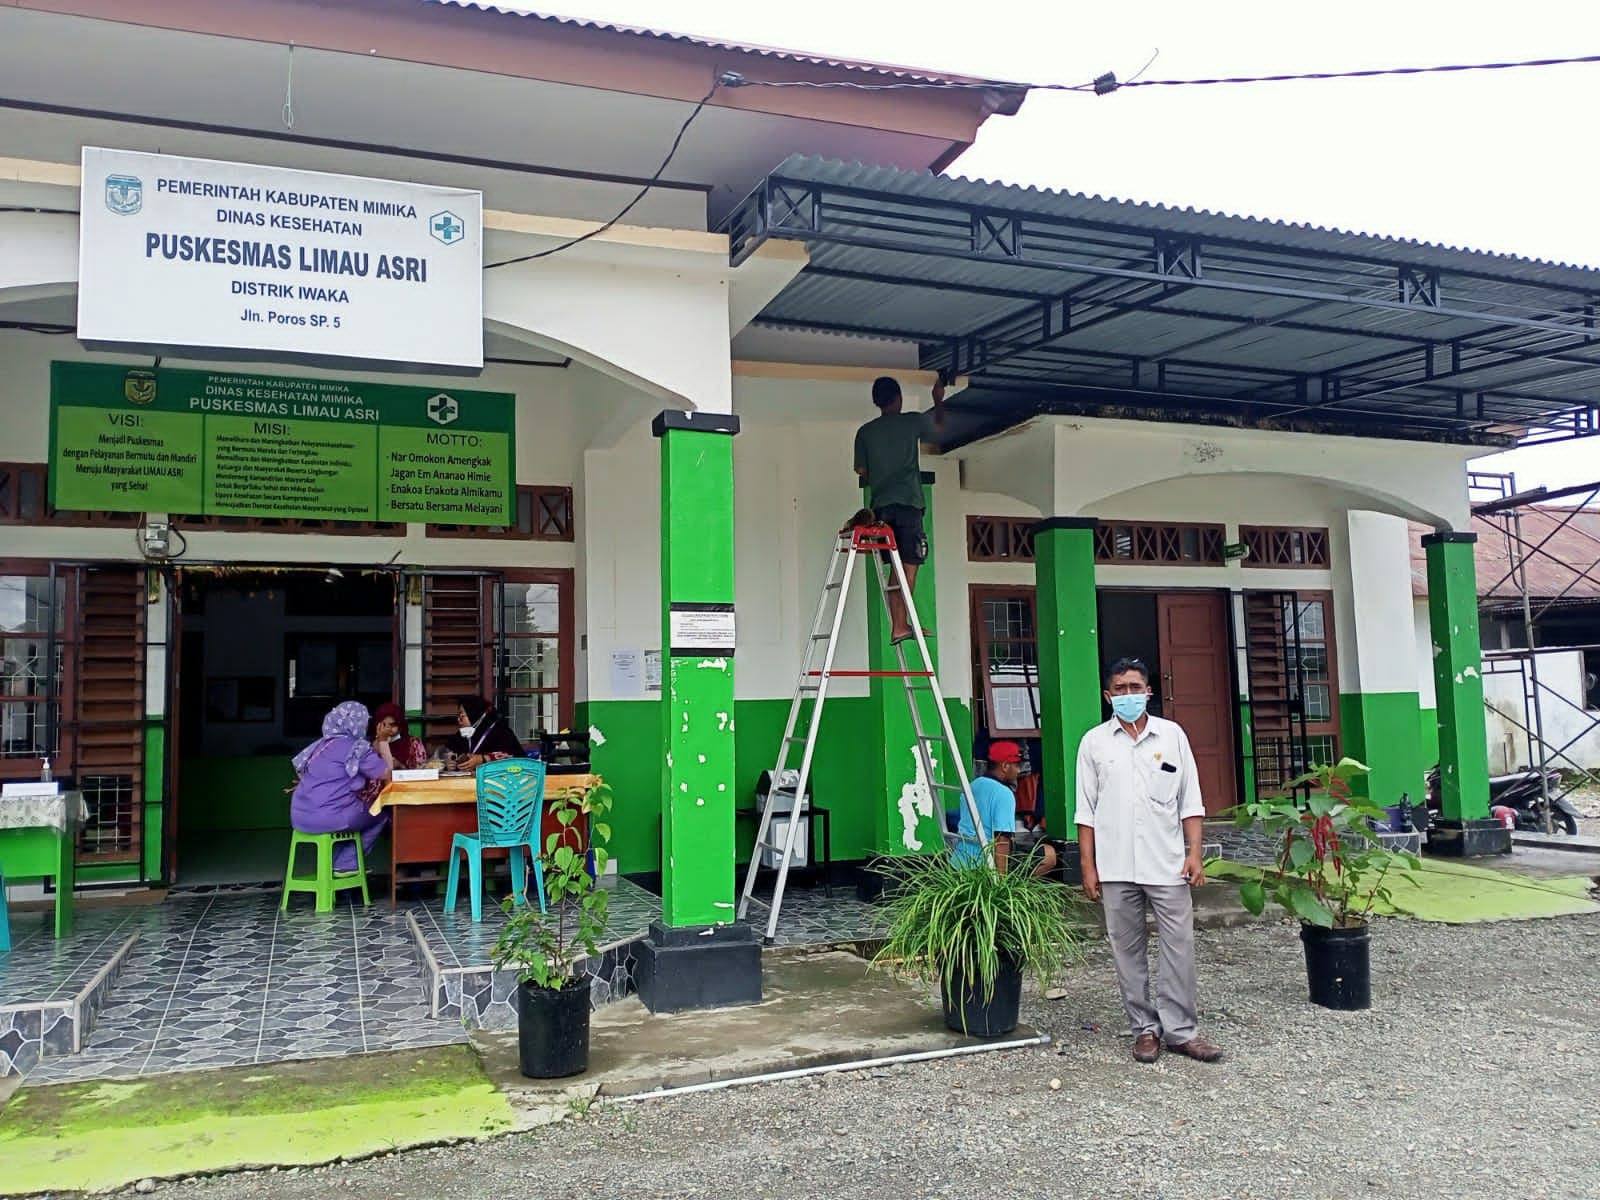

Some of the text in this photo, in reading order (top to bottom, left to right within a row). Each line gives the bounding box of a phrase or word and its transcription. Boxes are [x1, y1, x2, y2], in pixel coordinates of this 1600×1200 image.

[157, 178, 417, 218] PEMERINTAH KABUPATEN MIMIKA
[216, 209, 362, 236] DINAS KESEHATAN
[146, 232, 427, 282] PUSKESMAS LIMAU ASRI
[231, 280, 349, 303] DISTRIK IWAKA
[240, 308, 341, 328] Jln. Poros SP. 5
[208, 375, 349, 393] PEMERINTAH KABUPATEN MIMIKA
[206, 385, 364, 405] DINAS KESEHATAN MIMIKA
[189, 397, 380, 421] PUSKESMAS LIMAU ASRI
[108, 414, 144, 427] VISI:
[254, 422, 291, 436] MISI:
[427, 433, 482, 447] MOTTO:
[391, 452, 491, 468] Nar Omokon Amengkak
[390, 468, 415, 480] Jagan
[418, 469, 431, 478] Em
[391, 500, 503, 515] Bersatu Bersama Melayani
